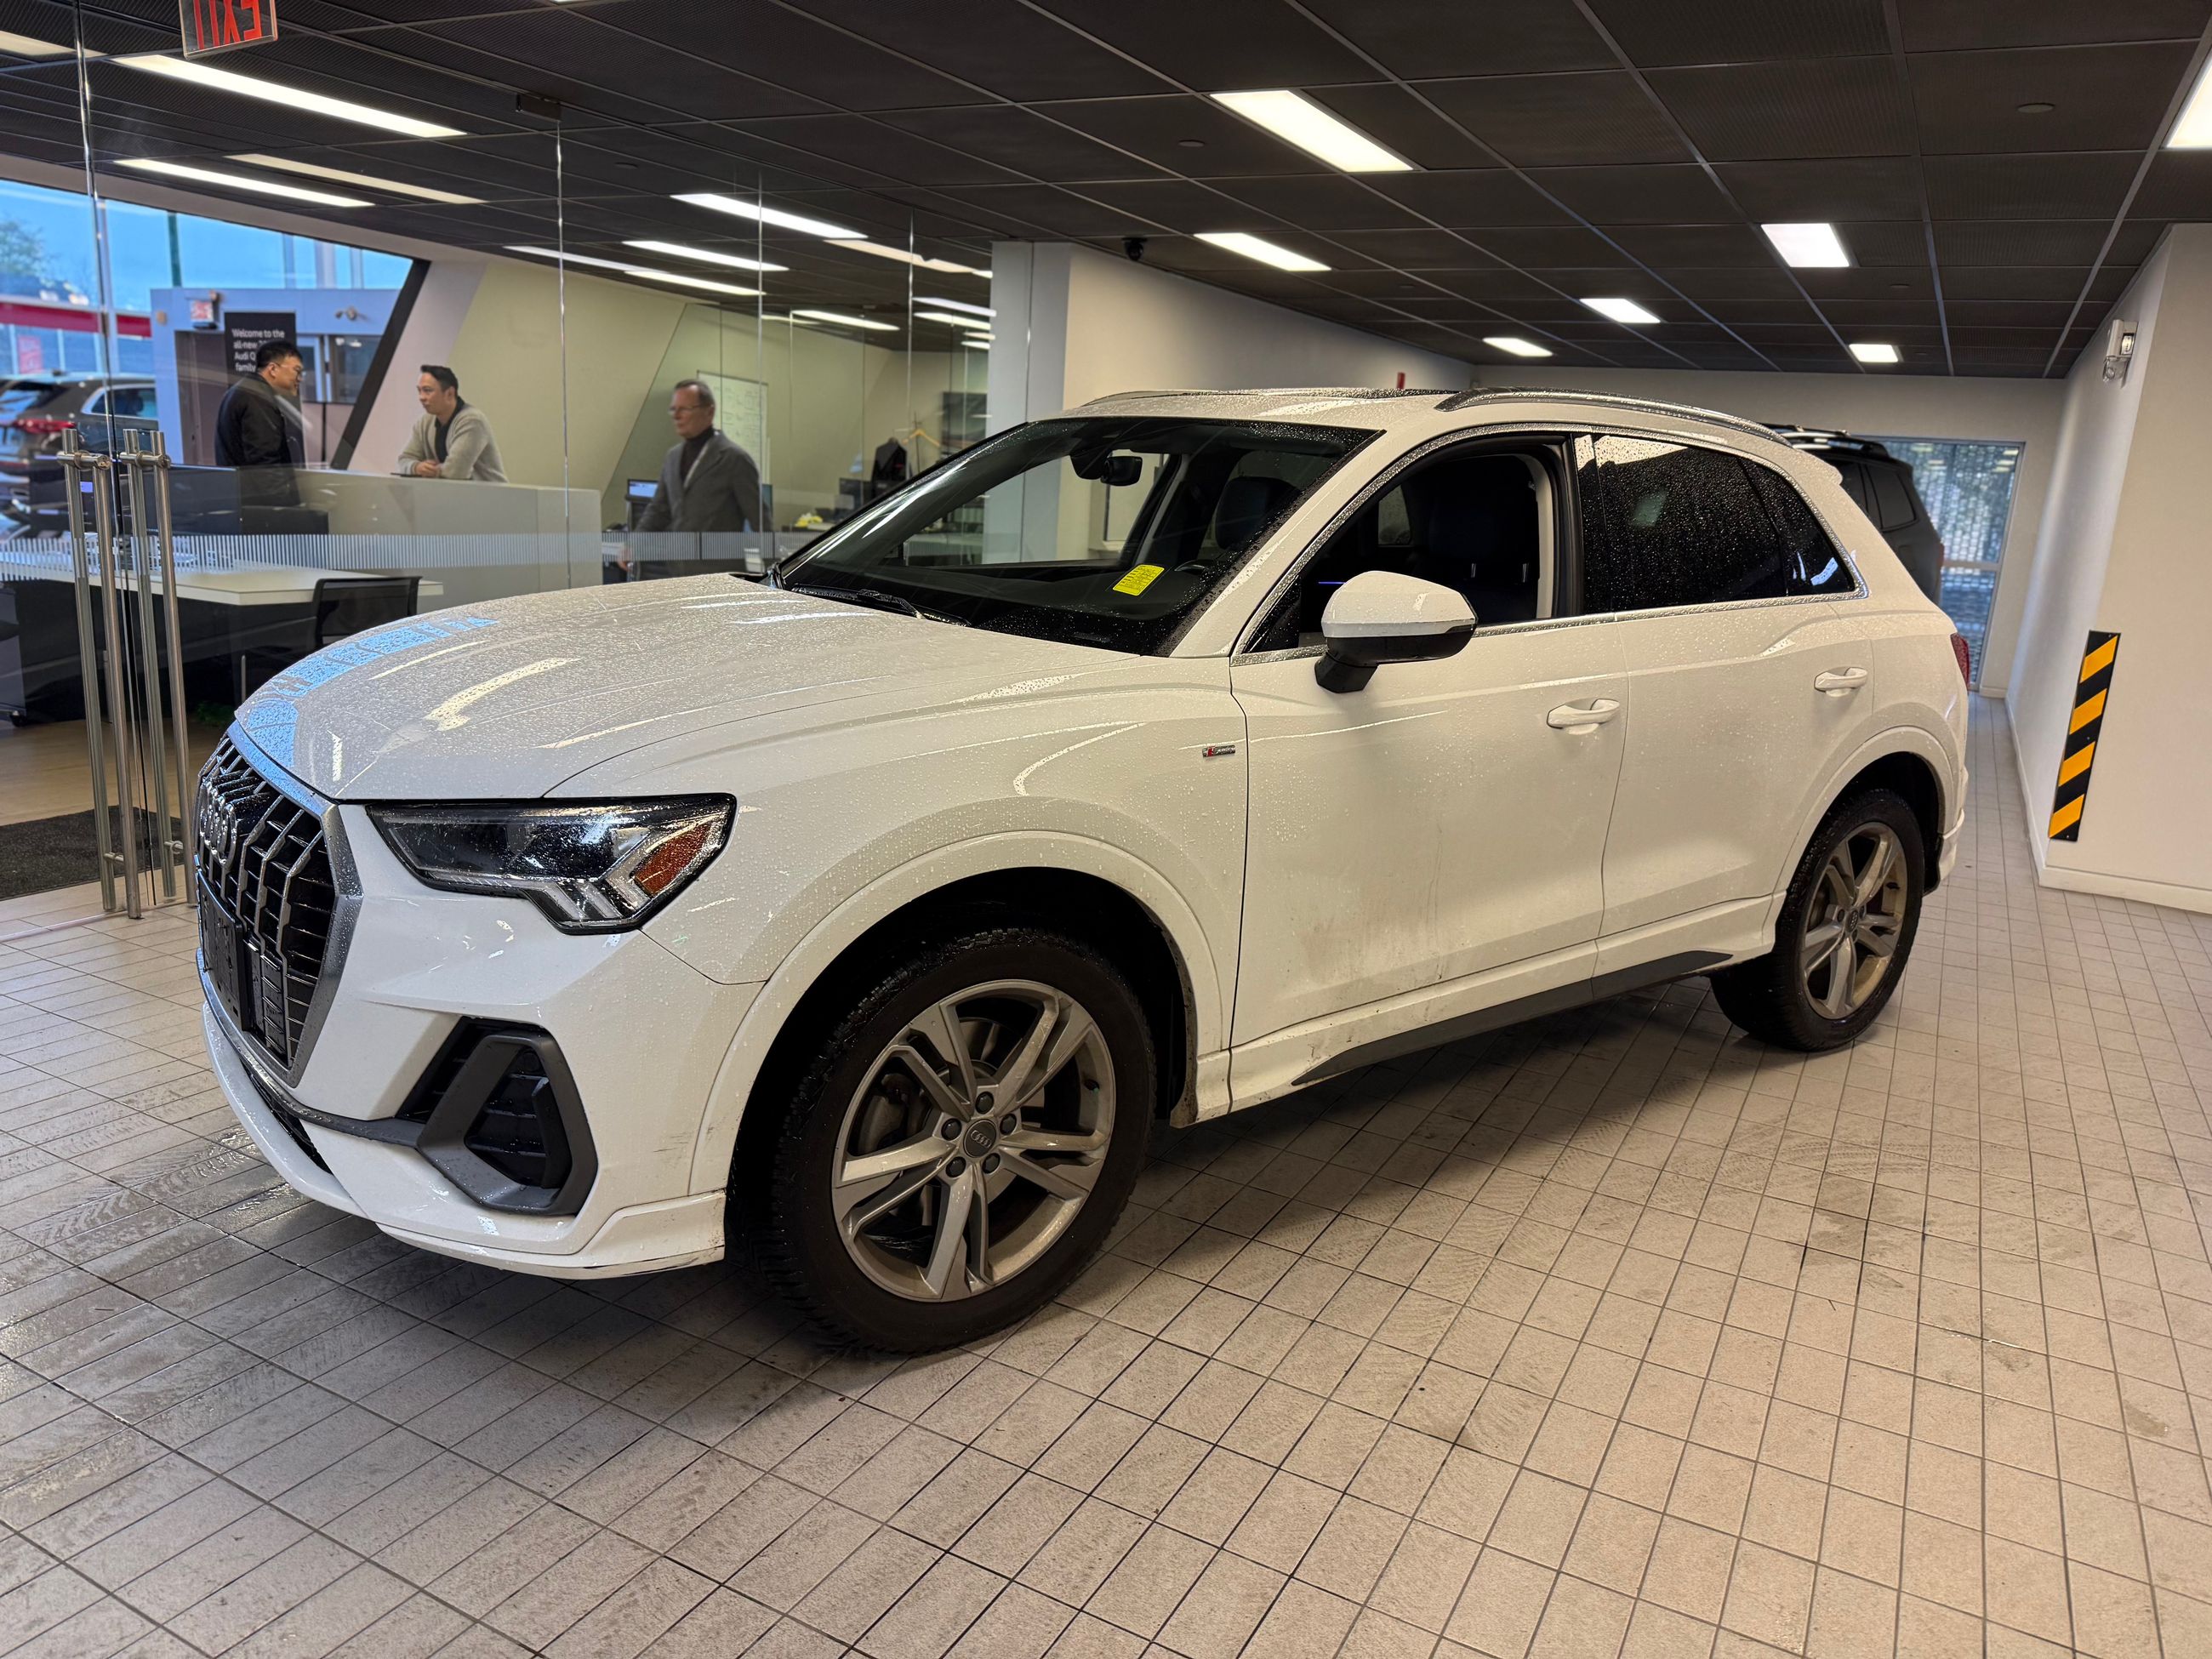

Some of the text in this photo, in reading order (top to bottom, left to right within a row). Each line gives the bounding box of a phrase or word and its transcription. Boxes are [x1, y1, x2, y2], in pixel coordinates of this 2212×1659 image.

[231, 328, 285, 339] Welcome to the
[233, 340, 258, 349] all-new
[234, 351, 248, 361] Audi
[235, 362, 256, 373] family
